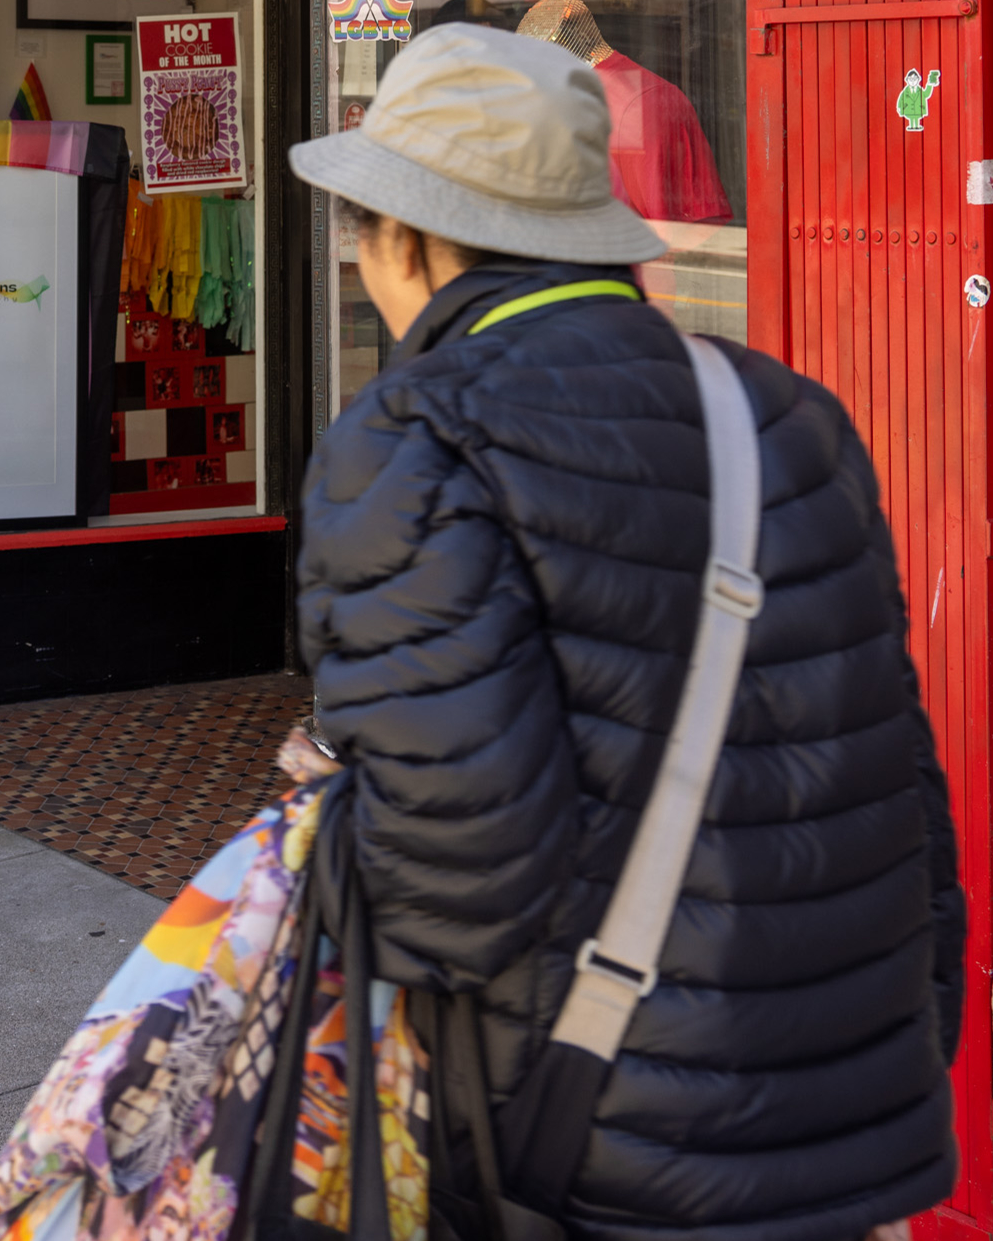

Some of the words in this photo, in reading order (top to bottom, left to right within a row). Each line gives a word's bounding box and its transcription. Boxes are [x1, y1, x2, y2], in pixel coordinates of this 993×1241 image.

[164, 22, 212, 44] HOT
[334, 20, 411, 41] LGBTQ
[166, 42, 213, 57] COOKIE
[159, 57, 170, 68] OF
[174, 56, 189, 67] THE
[193, 54, 222, 66] MONTH
